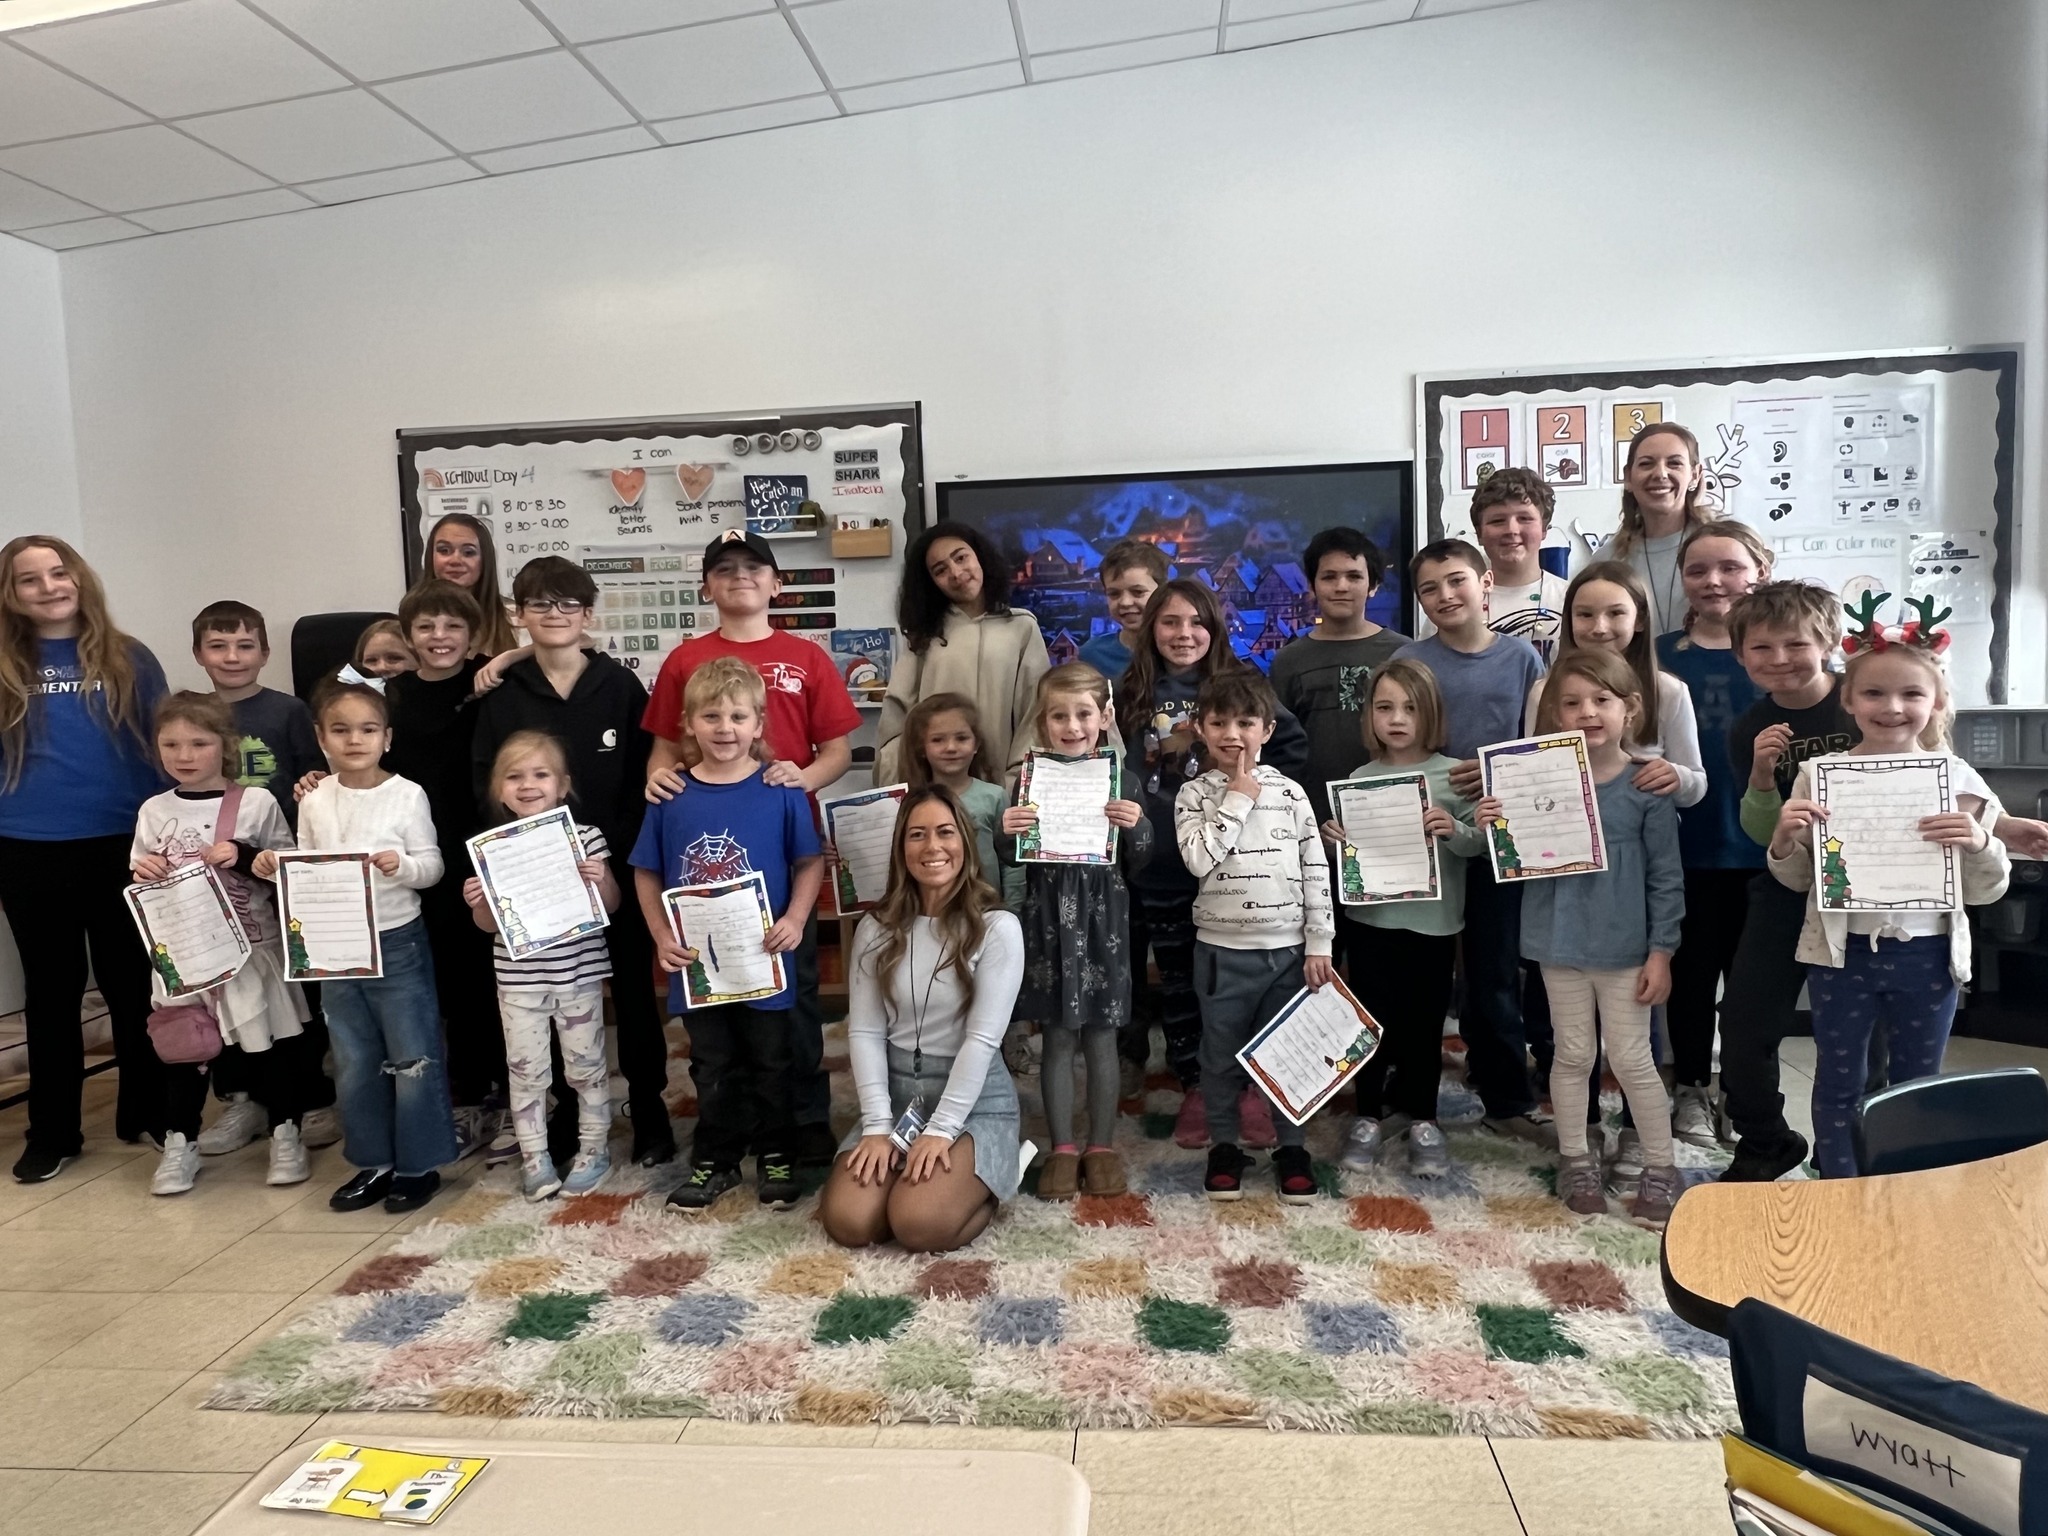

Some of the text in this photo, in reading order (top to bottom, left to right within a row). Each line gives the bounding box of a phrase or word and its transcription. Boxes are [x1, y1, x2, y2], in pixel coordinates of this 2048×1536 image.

[1481, 414, 1489, 441] 1
[1552, 412, 1571, 440] 2
[1629, 408, 1647, 436] 3
[632, 449, 642, 460] I
[835, 451, 878, 463] SUPER
[494, 469, 518, 486] Day
[835, 469, 881, 481] SHARK
[710, 513, 719, 524] 5
[586, 562, 632, 571] DECEMBER
[683, 593, 691, 602] 5
[662, 615, 675, 625] 11
[681, 615, 694, 625] 12
[645, 638, 657, 648] 17
[864, 632, 885, 649] Ho!
